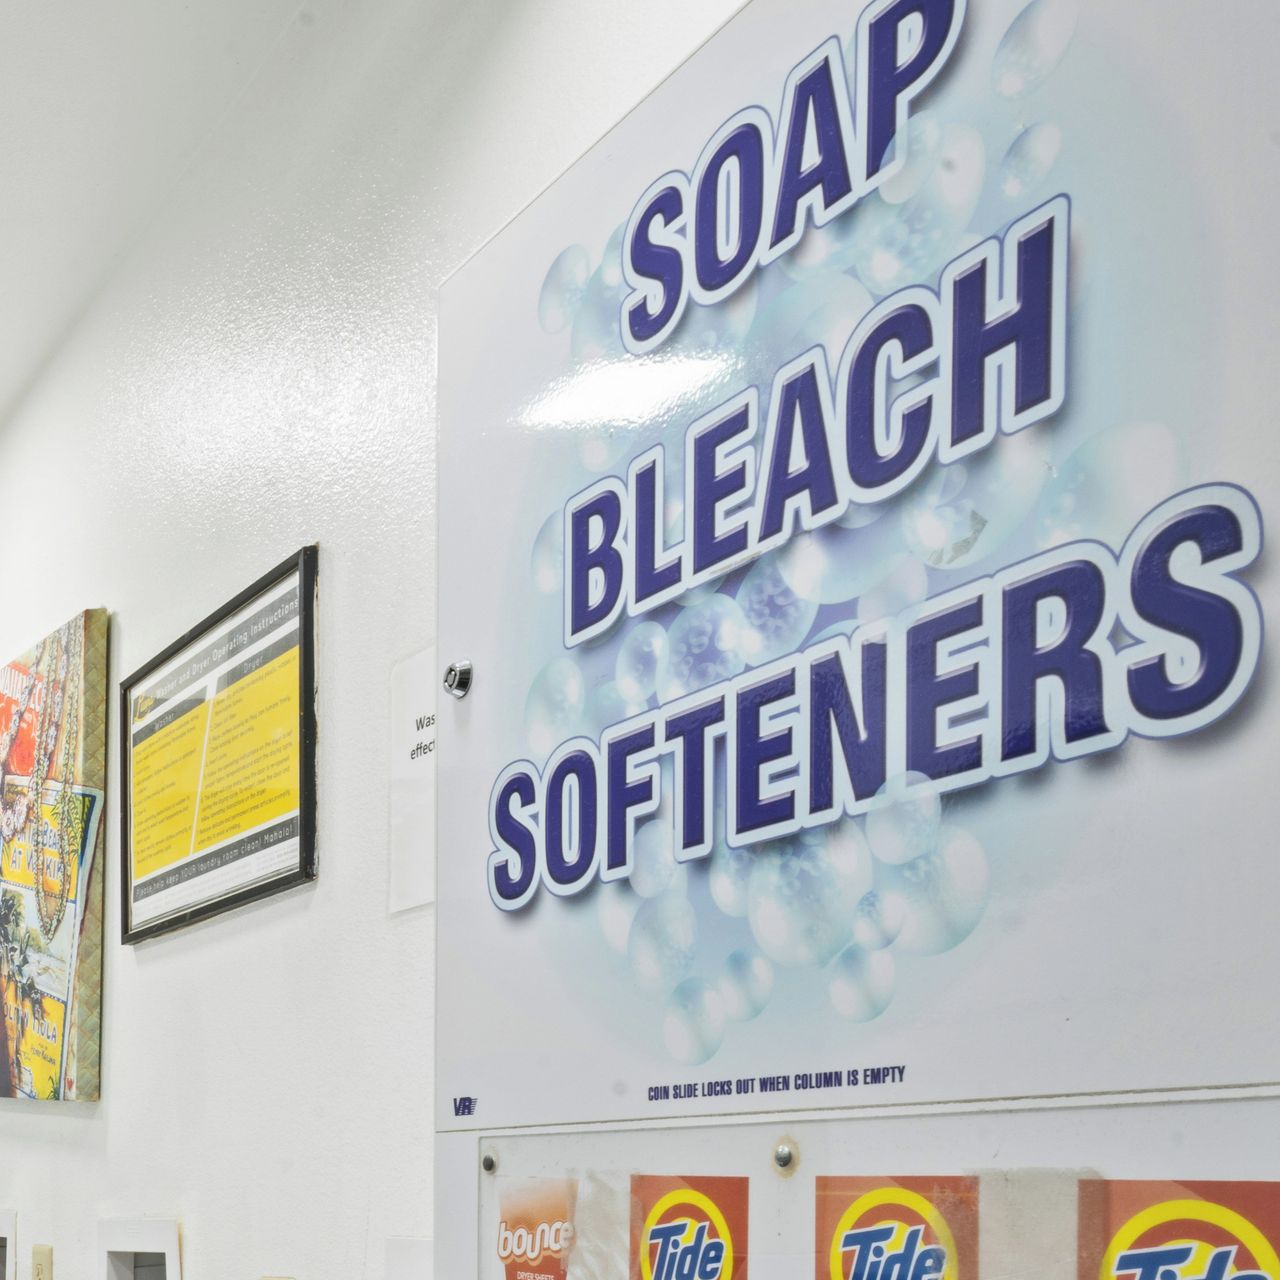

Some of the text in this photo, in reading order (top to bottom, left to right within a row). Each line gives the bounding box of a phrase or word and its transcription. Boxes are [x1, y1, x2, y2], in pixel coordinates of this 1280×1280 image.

[627, 0, 959, 344] SOAP
[570, 212, 1057, 640] BLEACH
[156, 679, 178, 699] Washer
[192, 656, 211, 675] Dryer
[212, 630, 248, 662] Operating
[250, 598, 299, 637] Instructions
[243, 655, 264, 674] Dryer
[154, 711, 175, 730] Washer
[416, 714, 435, 732] Was
[494, 503, 1244, 903] SOFTENERS
[165, 872, 179, 886] keep
[180, 865, 198, 880] YOUR
[197, 857, 221, 873] laundry
[222, 848, 239, 860] room
[263, 823, 293, 844] Mahalo!
[647, 1065, 906, 1101] COIN SLIDE LOCKS OUT WHEN COLUMN IS EMPTY
[498, 1220, 575, 1260] bounce
